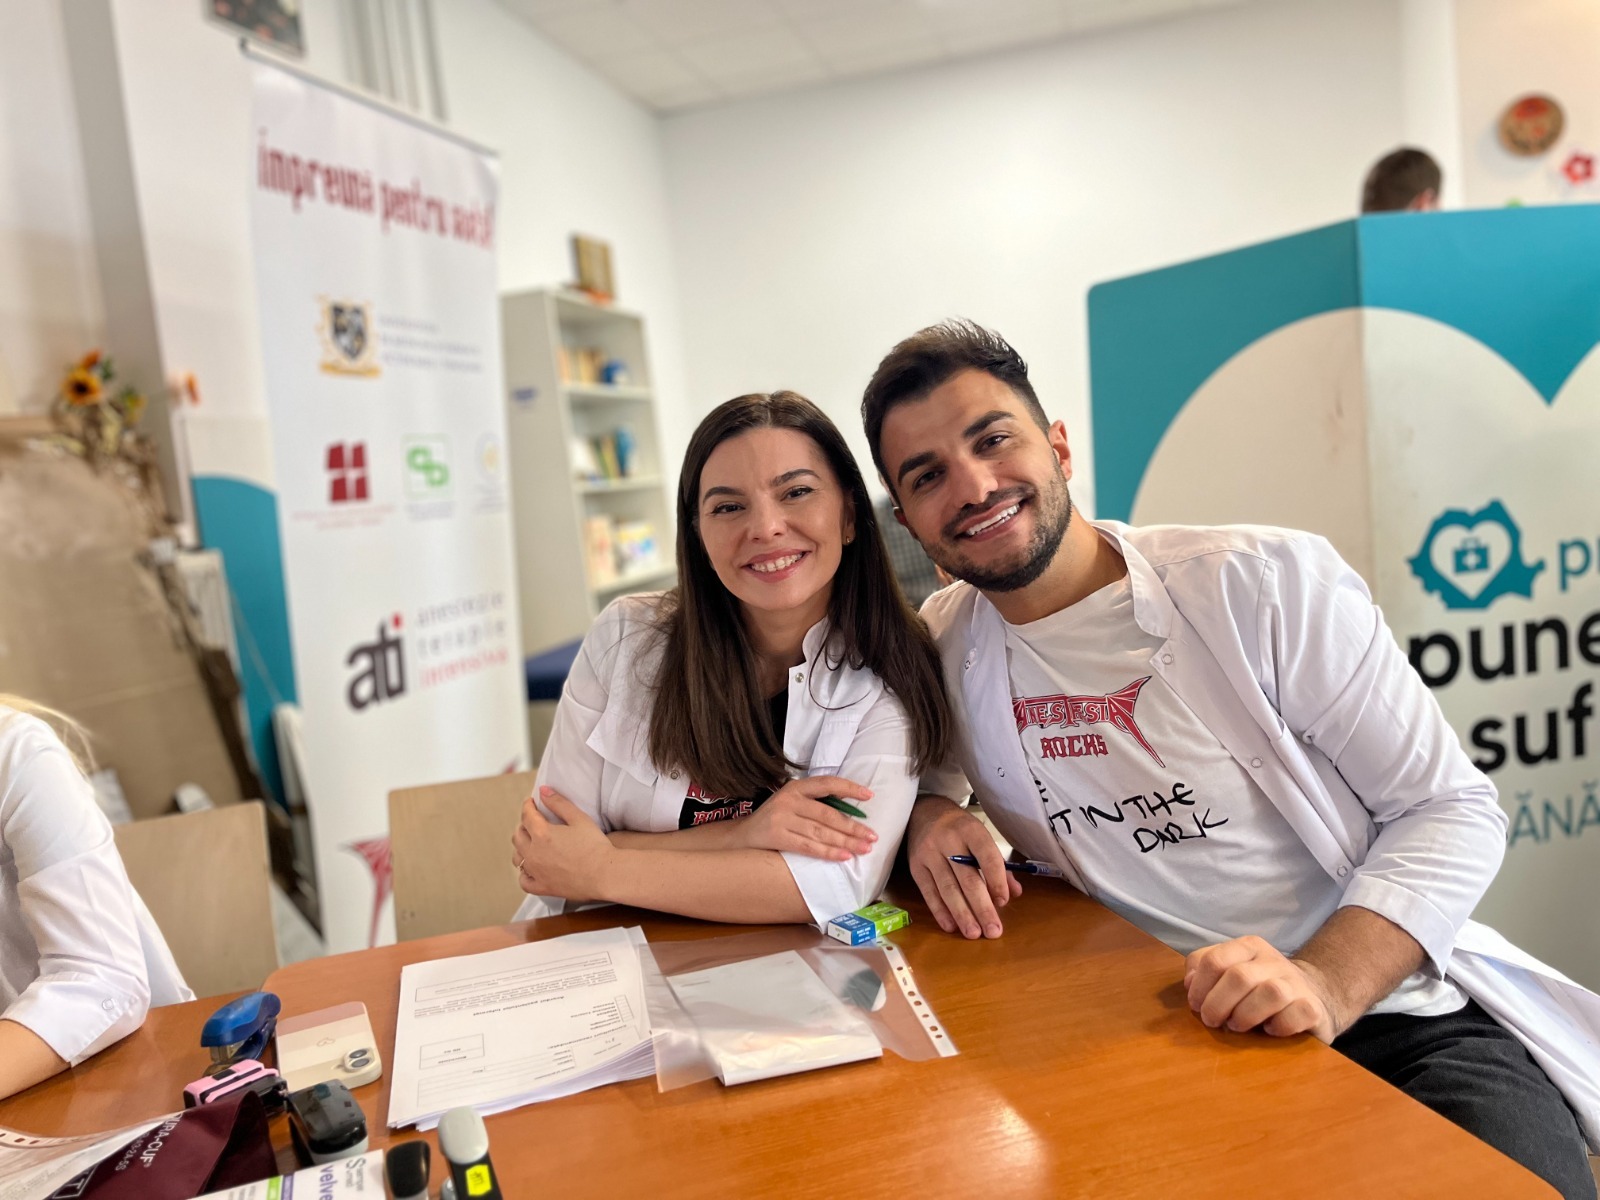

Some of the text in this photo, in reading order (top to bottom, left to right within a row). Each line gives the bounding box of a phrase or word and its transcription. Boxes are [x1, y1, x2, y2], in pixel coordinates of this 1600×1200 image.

[1557, 532, 1600, 593] p
[344, 612, 408, 712] ati
[1407, 614, 1600, 690] pune
[1040, 733, 1109, 760] ROCKS
[1470, 681, 1593, 776] suf
[1122, 782, 1196, 820] THE
[1132, 808, 1229, 853] DARK
